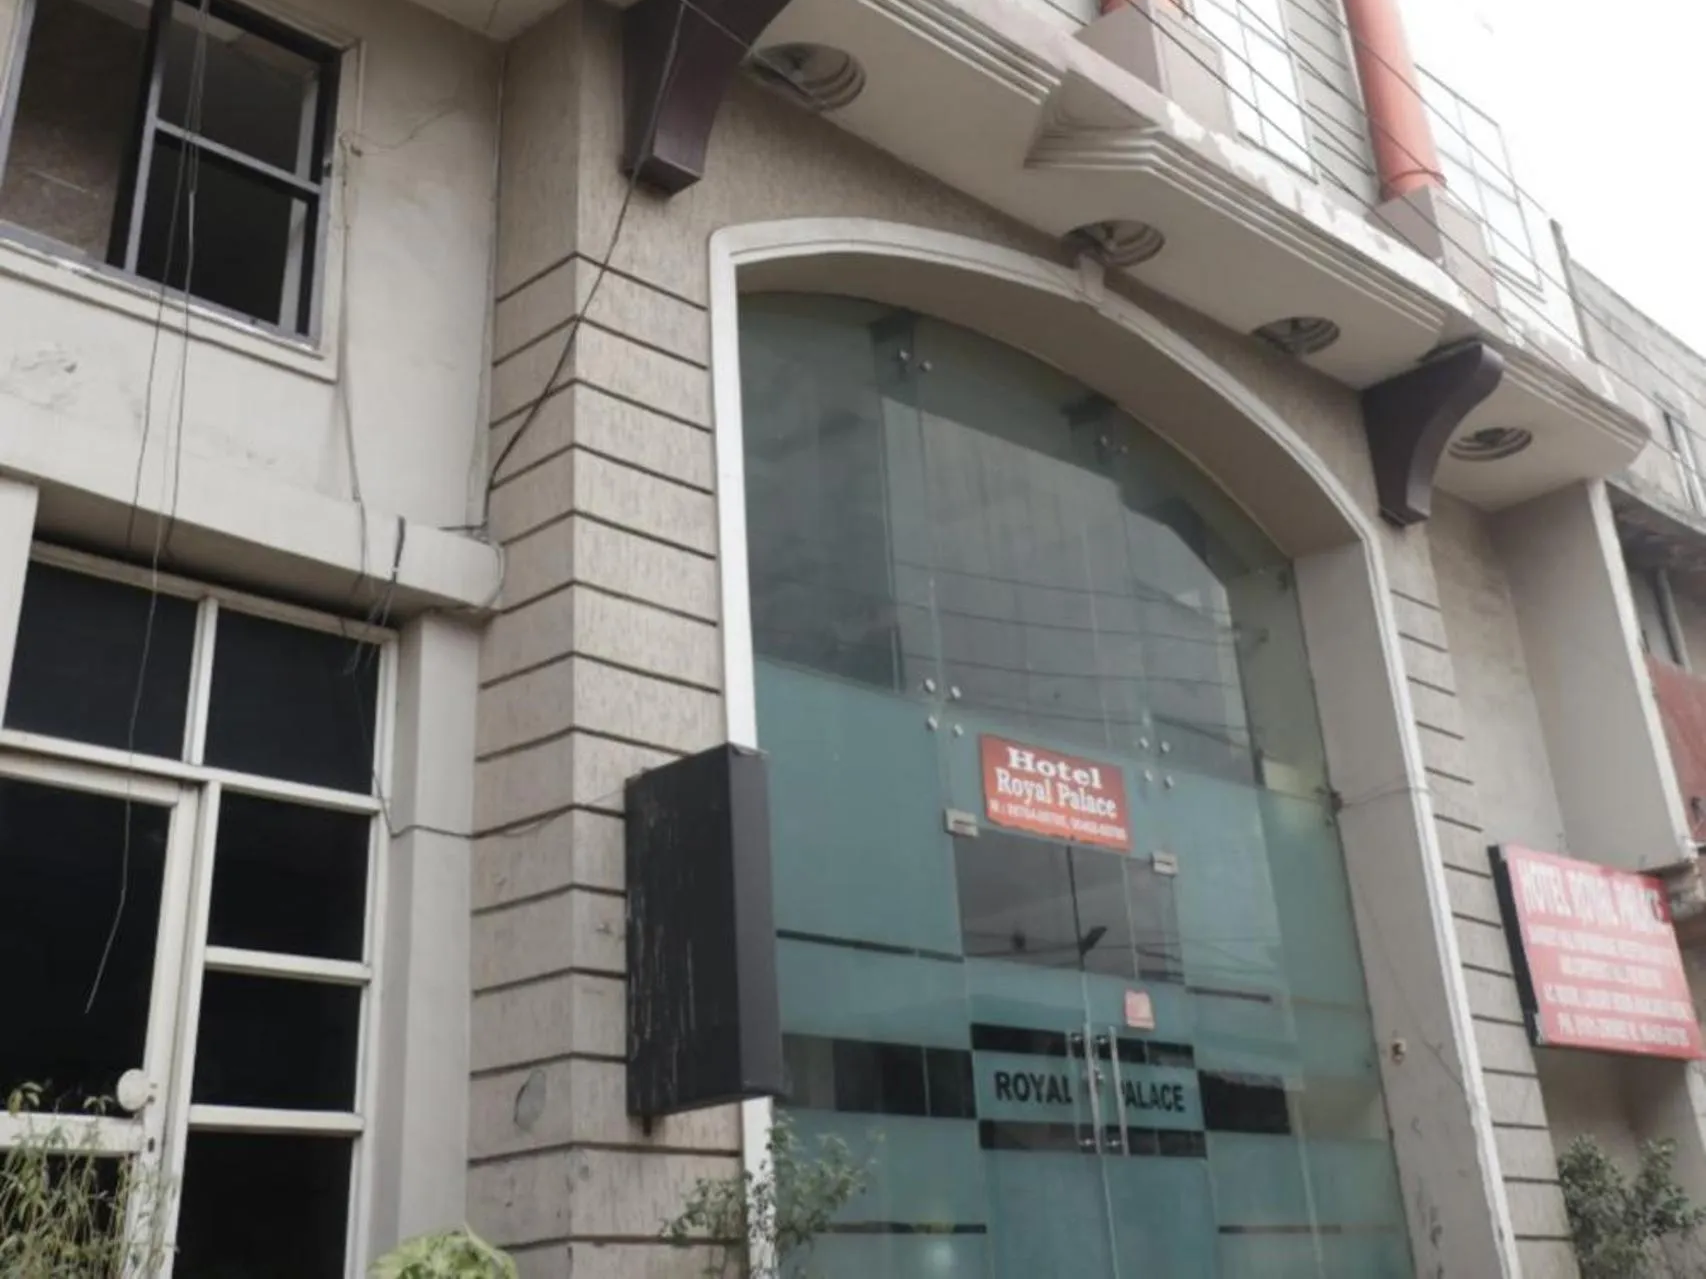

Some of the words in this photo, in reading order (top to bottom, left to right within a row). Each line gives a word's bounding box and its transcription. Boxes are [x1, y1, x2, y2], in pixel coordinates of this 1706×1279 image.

[1006, 746, 1103, 789] Hotel
[995, 766, 1053, 805] Royal
[1056, 781, 1118, 819] Palace
[994, 1070, 1073, 1105] ROYAL
[1120, 1078, 1187, 1113] ALACE
